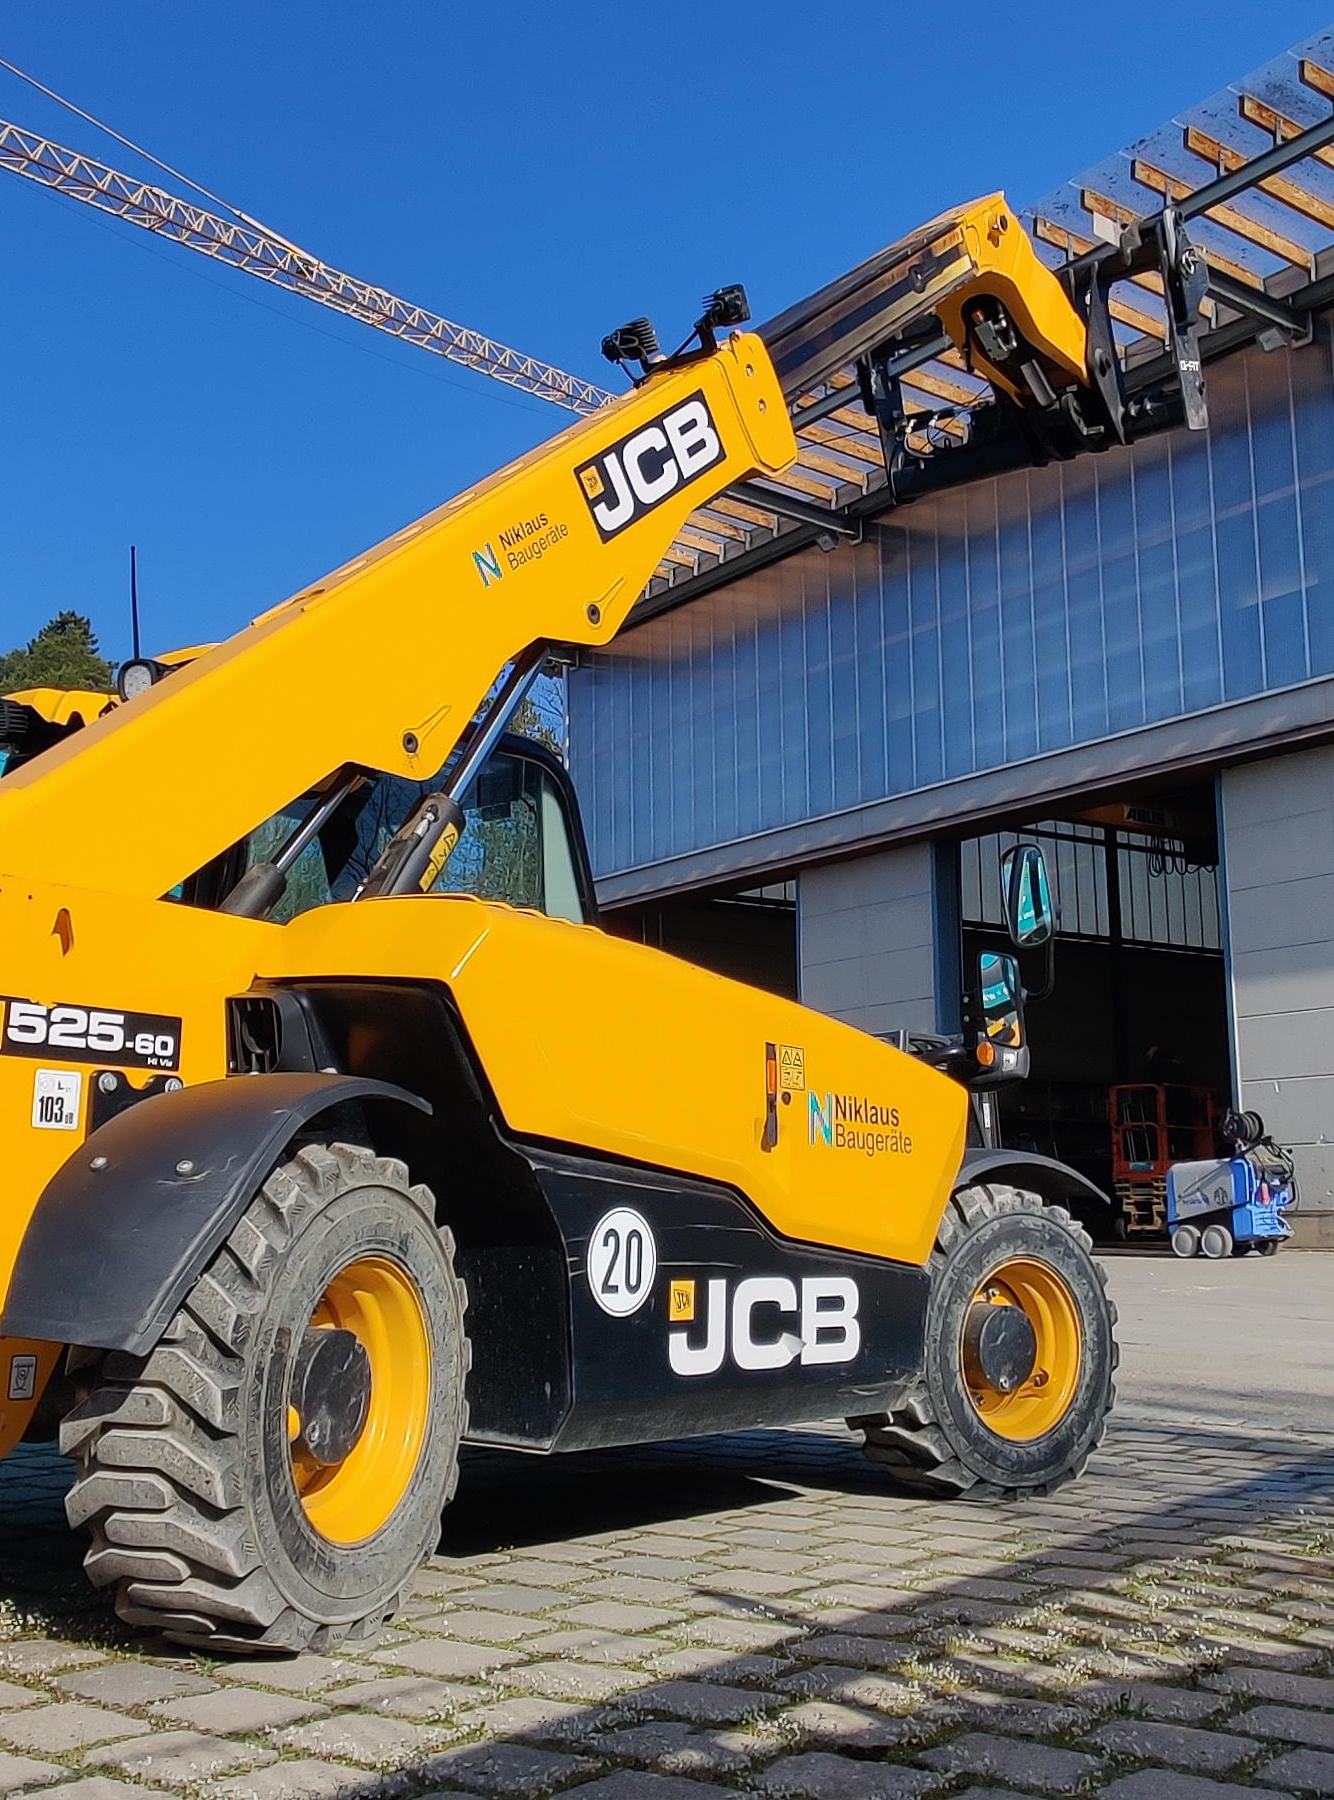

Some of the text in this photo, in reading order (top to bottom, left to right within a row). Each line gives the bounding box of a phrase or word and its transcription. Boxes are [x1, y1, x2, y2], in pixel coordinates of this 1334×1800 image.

[593, 401, 720, 532] JCB
[499, 512, 549, 551] Niklaus
[507, 523, 569, 571] Baugeräte
[472, 542, 503, 588] N
[1126, 807, 1166, 826] ABUS
[6, 1001, 175, 1057] 525-60
[38, 1095, 65, 1123] 103
[808, 1091, 833, 1147] N
[835, 1094, 900, 1127] Niklaus
[835, 1123, 913, 1157] Baugeräte
[601, 1228, 643, 1296] 20
[668, 1276, 862, 1377] JCB
